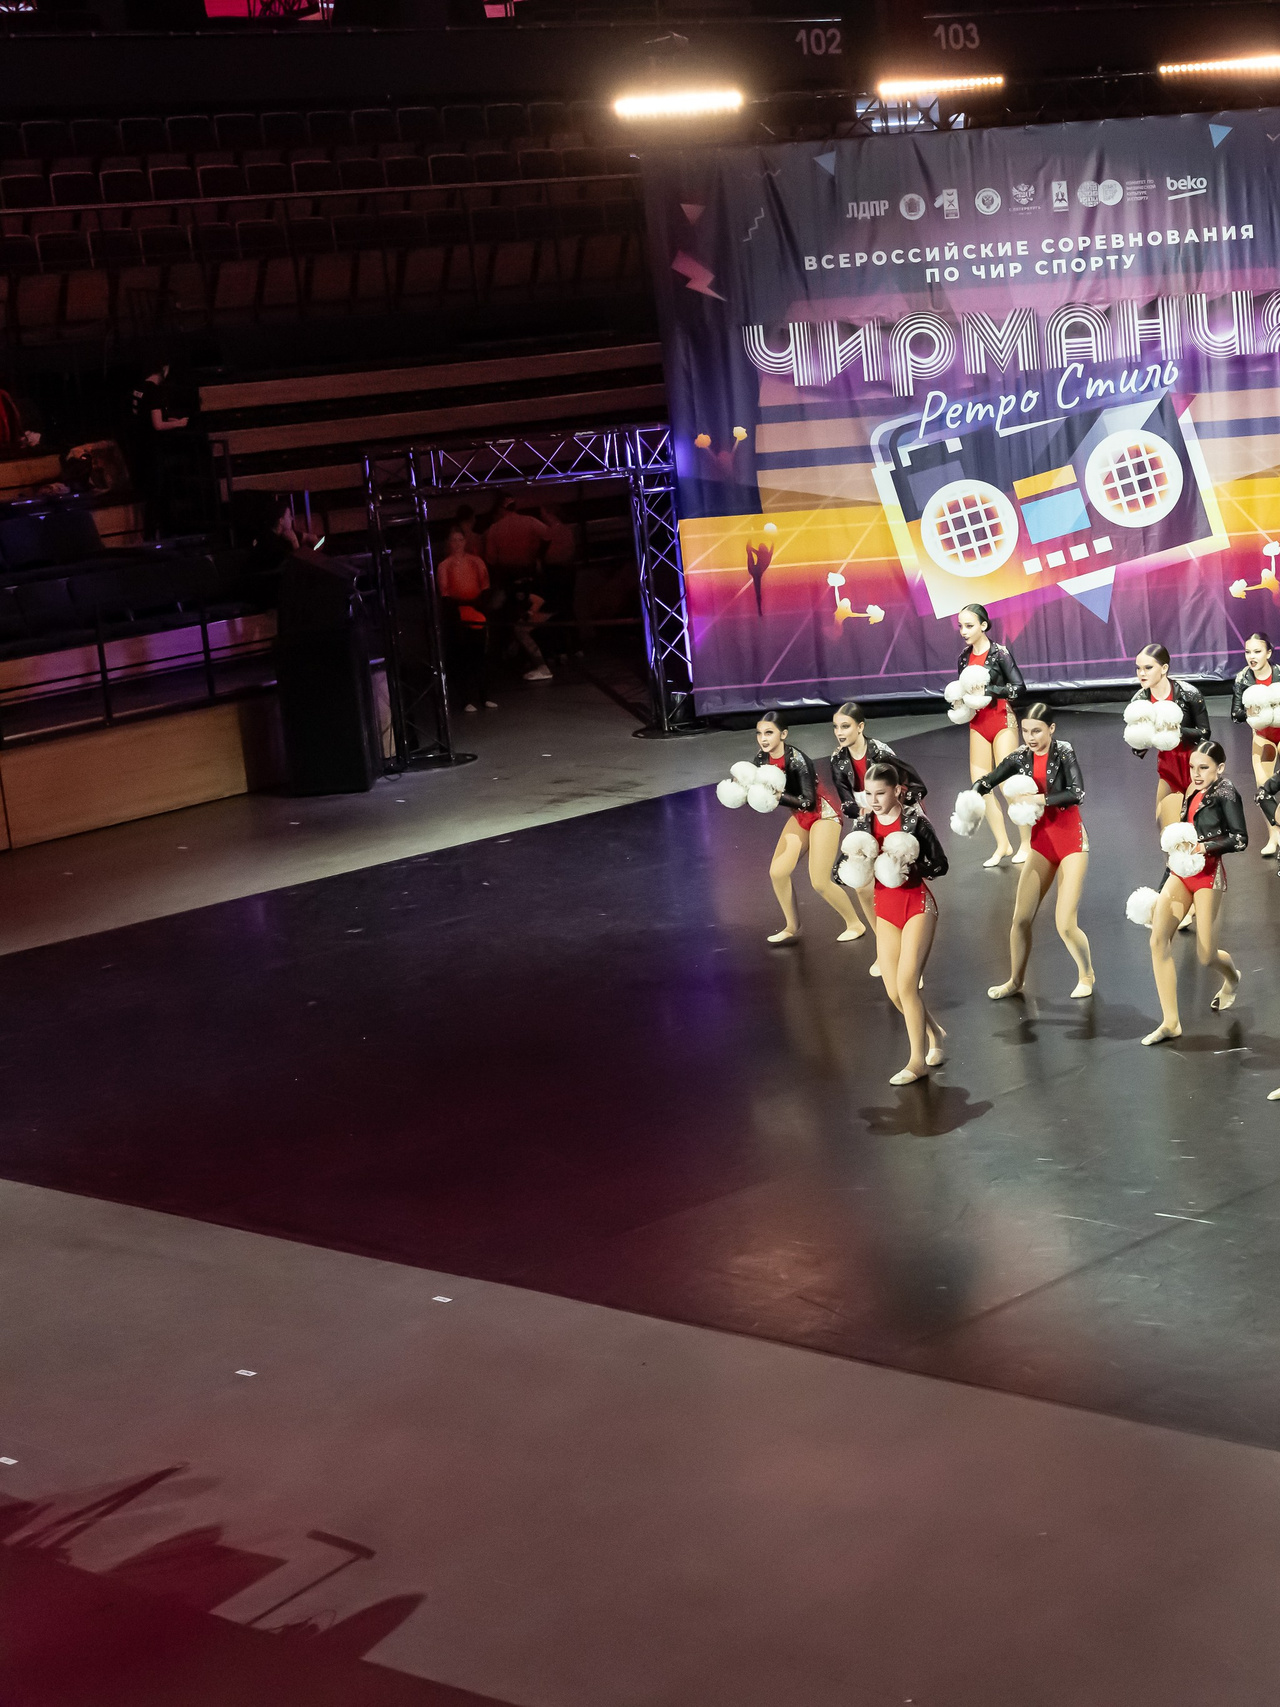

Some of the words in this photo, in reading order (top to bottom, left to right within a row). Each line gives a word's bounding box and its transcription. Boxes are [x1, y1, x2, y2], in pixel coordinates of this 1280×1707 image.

[796, 28, 842, 55] 102
[933, 23, 980, 50] 103
[1166, 175, 1207, 191] beko
[846, 200, 889, 220] ЛДПР
[804, 240, 1029, 271] ВСЕРОССИЙСКИЕ
[1041, 224, 1255, 254] СОРЕВНОВАНИЯ
[925, 267, 960, 283] ПО
[971, 262, 1023, 280] ЧИР
[1034, 253, 1136, 276] СПОРТУ
[918, 389, 1040, 439] Ретро
[1056, 360, 1179, 409] Стиль
